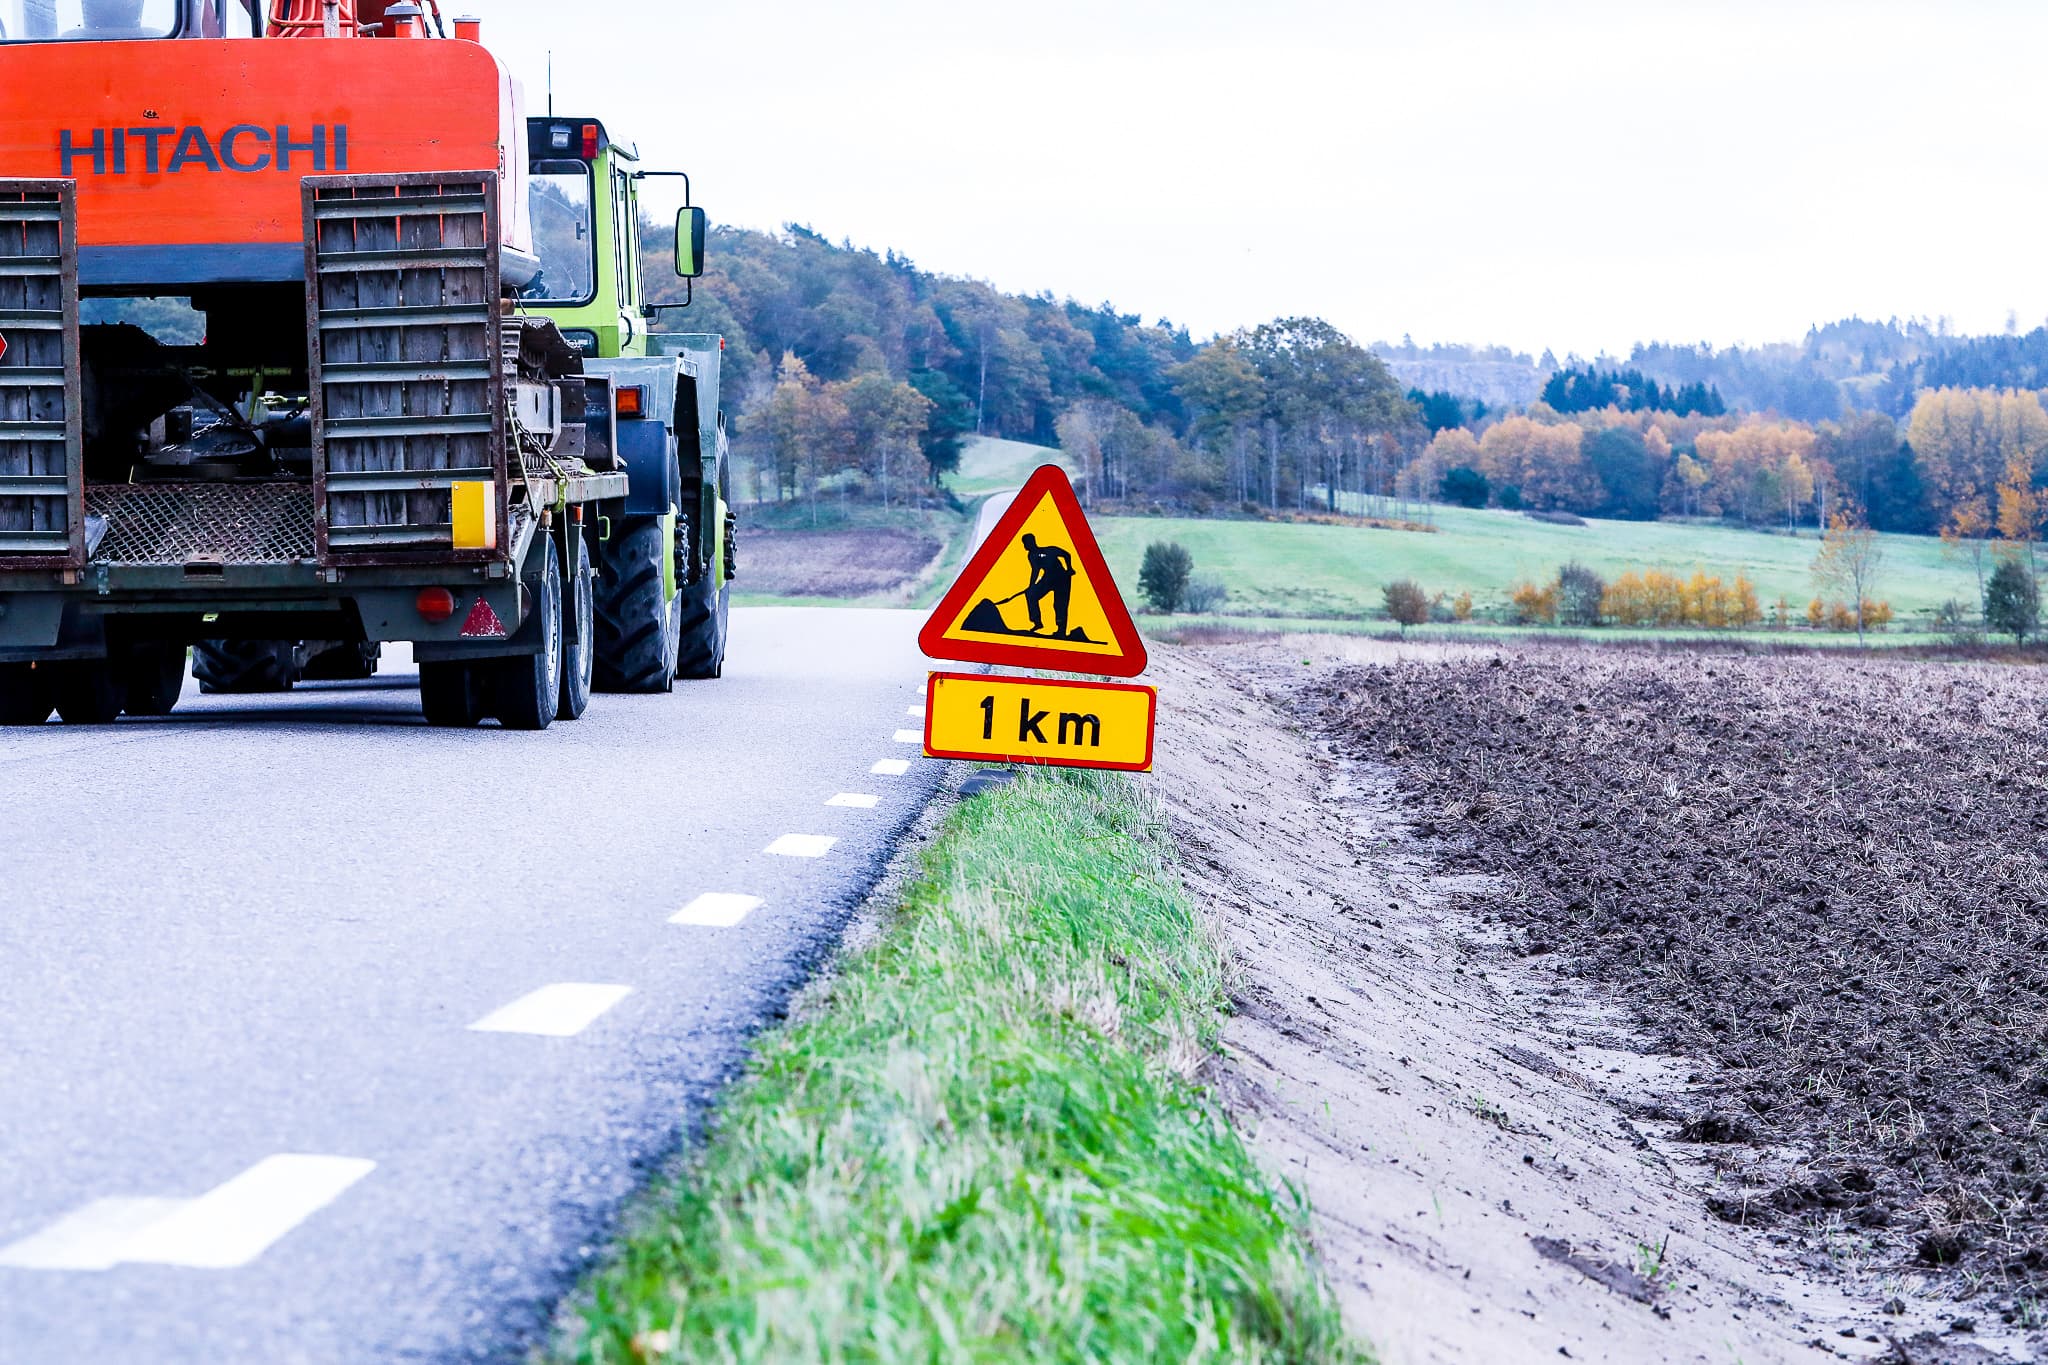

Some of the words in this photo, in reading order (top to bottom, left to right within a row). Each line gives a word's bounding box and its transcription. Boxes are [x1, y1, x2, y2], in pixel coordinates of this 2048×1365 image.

[59, 123, 348, 176] HITACHI
[980, 696, 995, 740] 1
[1018, 697, 1100, 747] km
